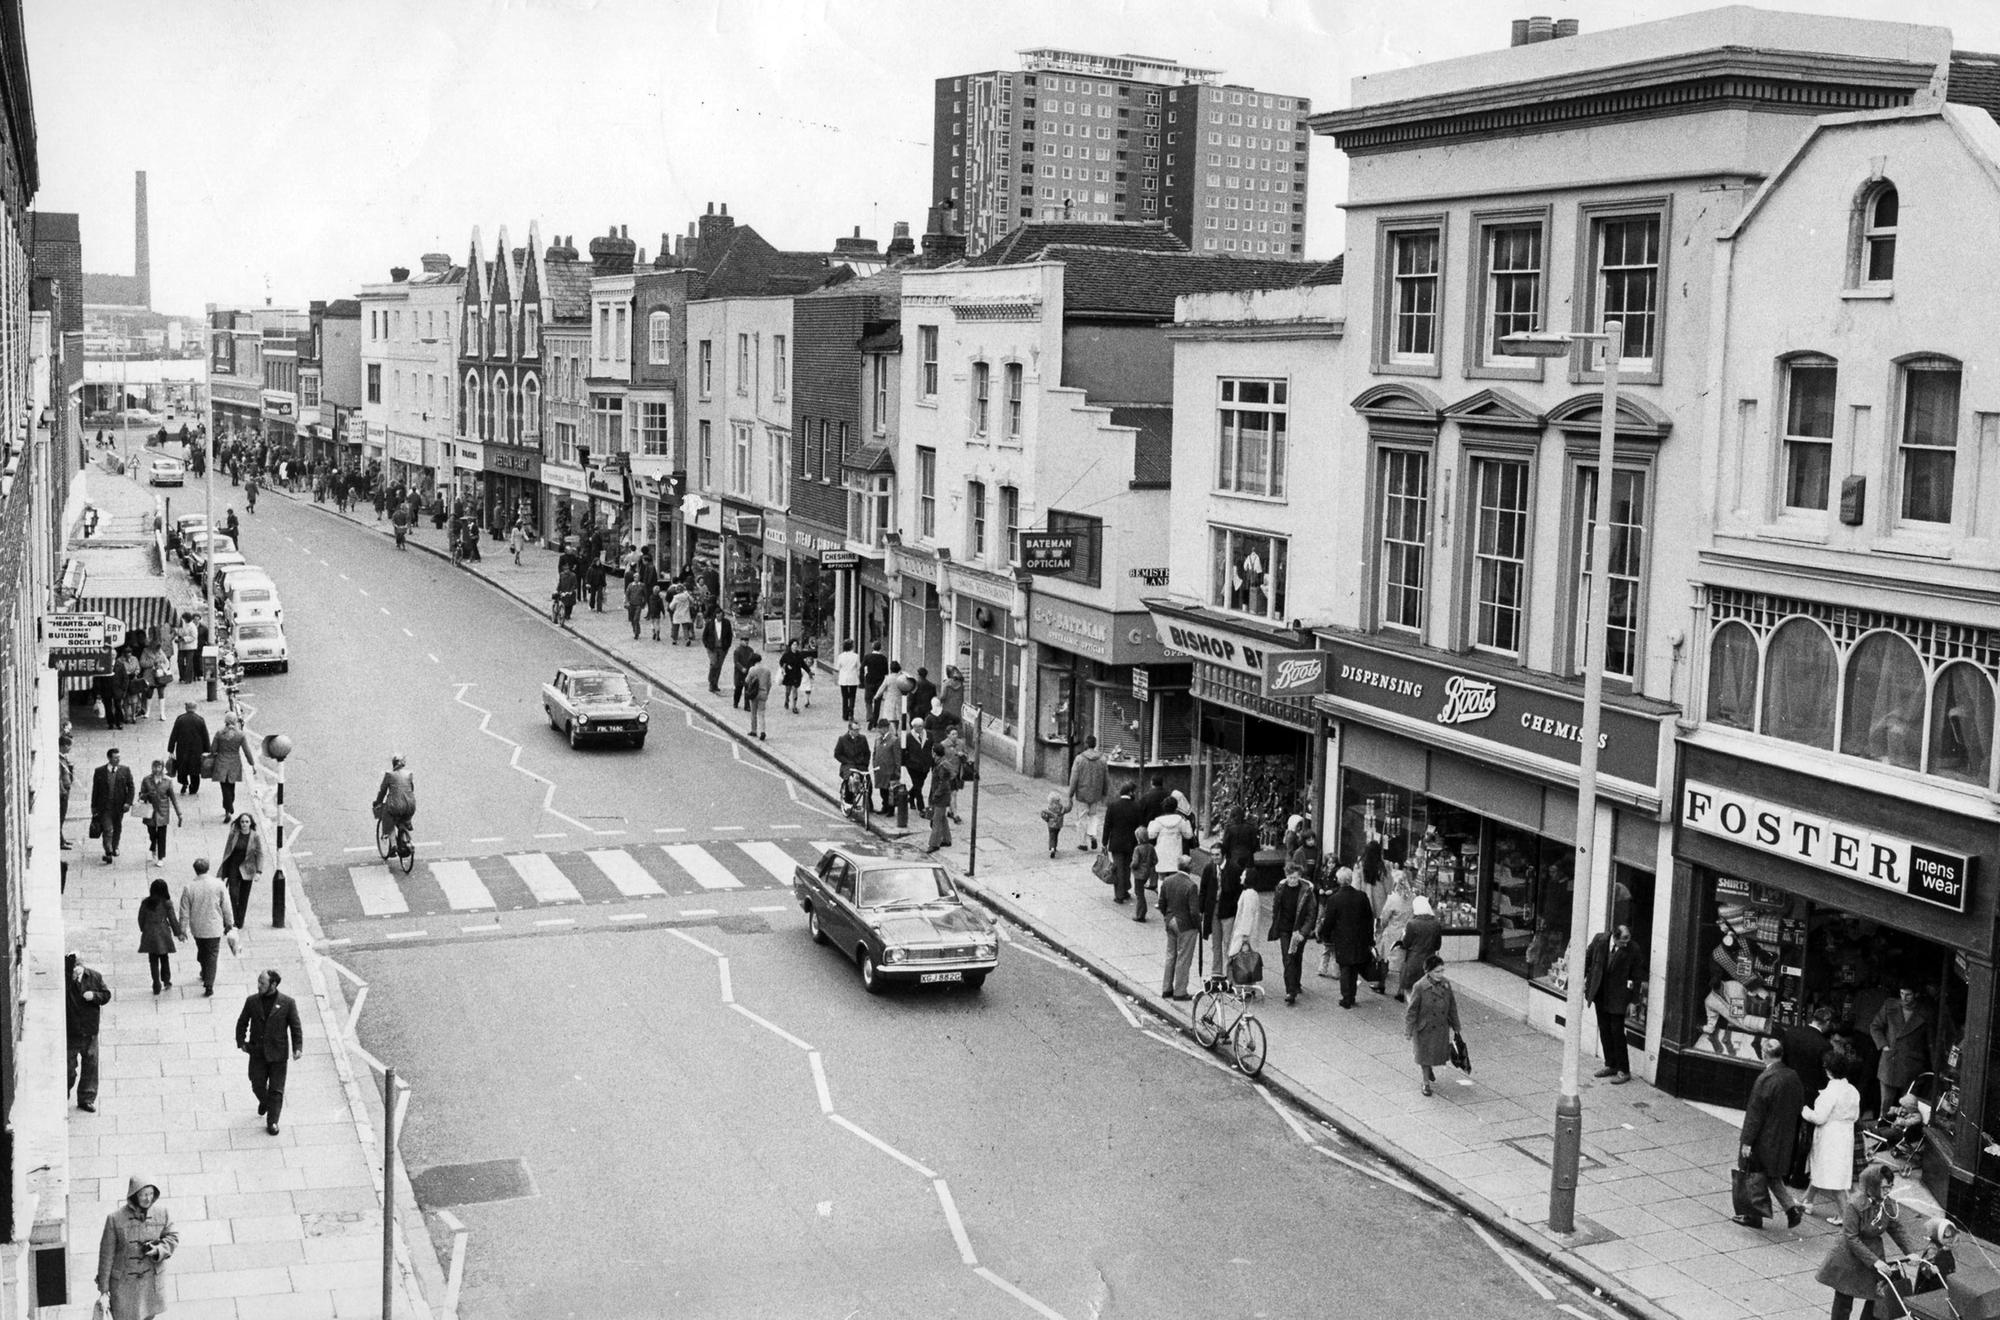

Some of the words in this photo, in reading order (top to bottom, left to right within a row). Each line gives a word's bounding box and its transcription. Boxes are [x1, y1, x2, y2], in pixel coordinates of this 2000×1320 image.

[1026, 539, 1072, 549] BATEMAN
[824, 553, 857, 561] CHESHIRE
[1026, 559, 1071, 568] OPTICIAN
[1144, 578, 1169, 587] LANE
[1169, 625, 1235, 661] BISHOP
[55, 659, 105, 672] WHEEL
[1271, 658, 1322, 689] Boots
[1341, 664, 1423, 698] DISPENSING
[1437, 675, 1497, 723] Boots
[1520, 711, 1609, 749] CHEMISS
[1686, 790, 1901, 884] FOSTER
[1915, 855, 1955, 880] mens
[1718, 877, 1749, 892] SHIRTS
[1922, 873, 1960, 897] wear
